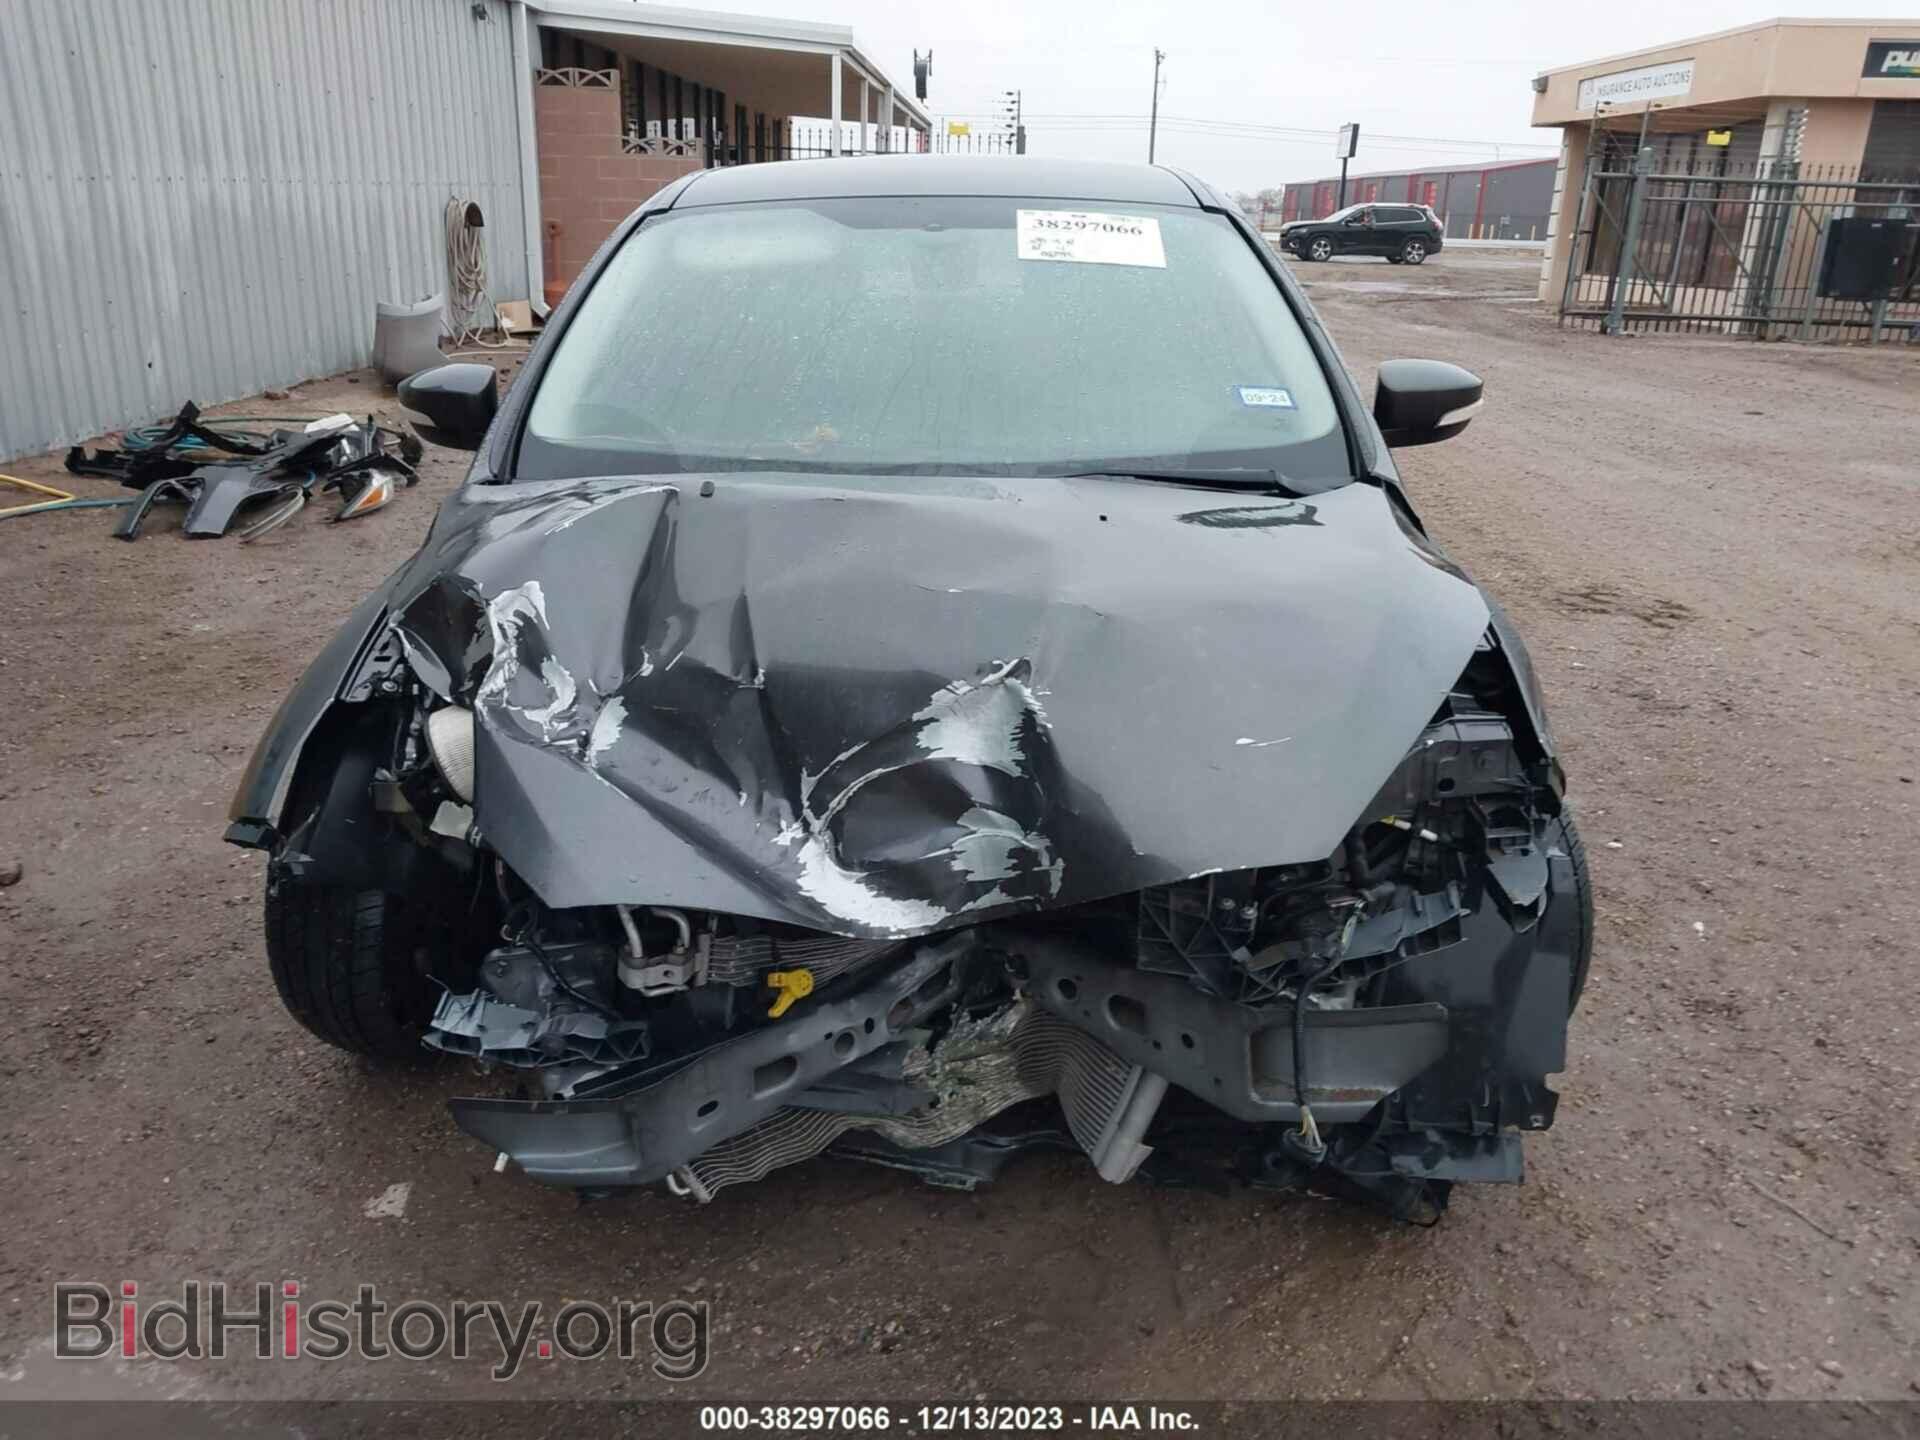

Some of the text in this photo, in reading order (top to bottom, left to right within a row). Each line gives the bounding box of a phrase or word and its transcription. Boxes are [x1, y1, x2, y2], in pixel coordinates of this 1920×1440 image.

[1633, 75, 1652, 92] AUTO
[1652, 69, 1691, 89] AUCTIONS
[1032, 217, 1143, 237] 38297066
